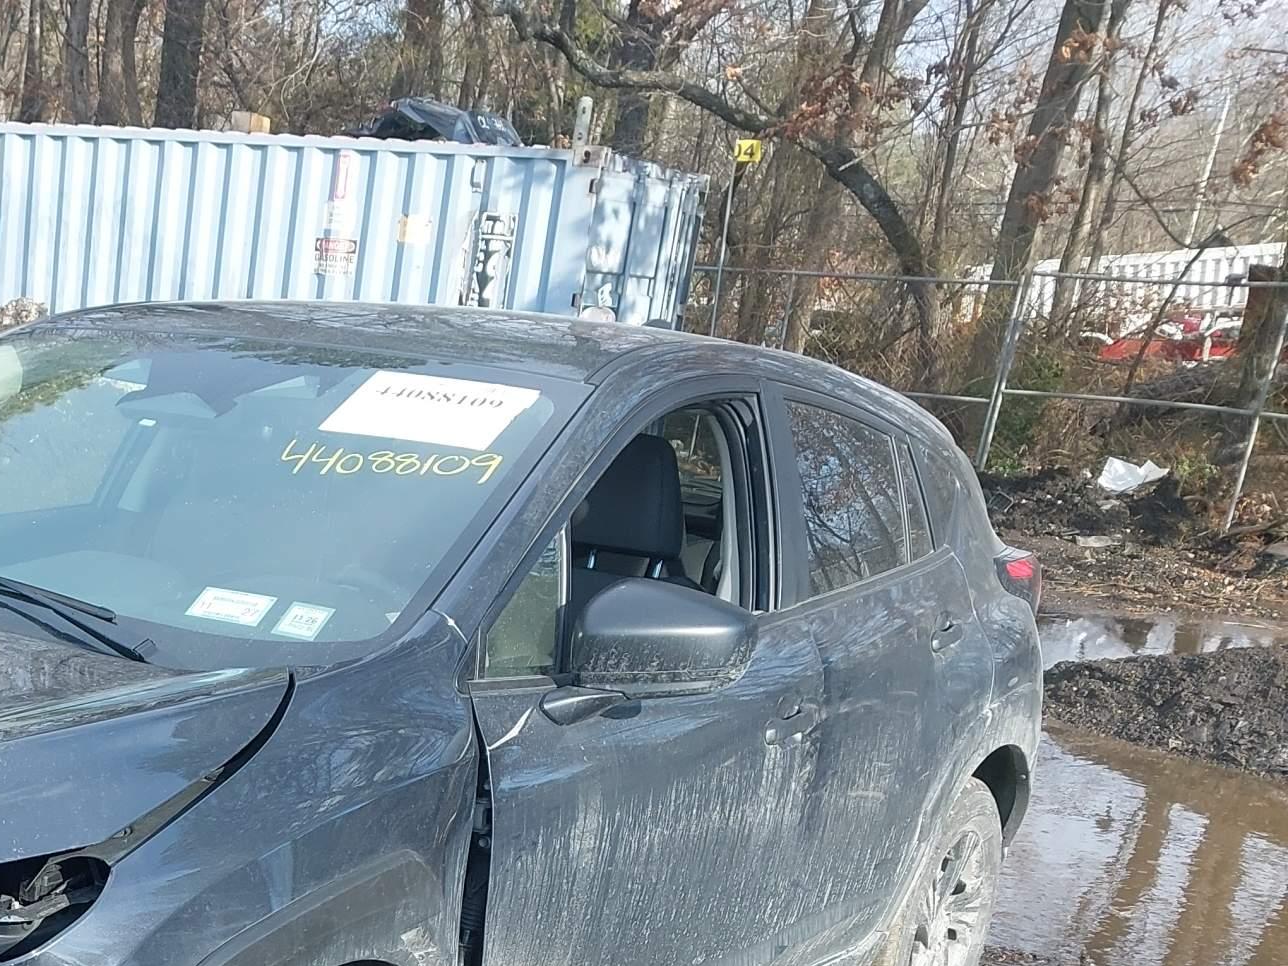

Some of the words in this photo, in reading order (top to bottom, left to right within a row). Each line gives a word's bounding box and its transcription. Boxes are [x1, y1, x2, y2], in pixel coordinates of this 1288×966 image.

[314, 252, 355, 264] GASOLINE
[376, 385, 504, 409] 44088109
[280, 438, 504, 485] 44088109
